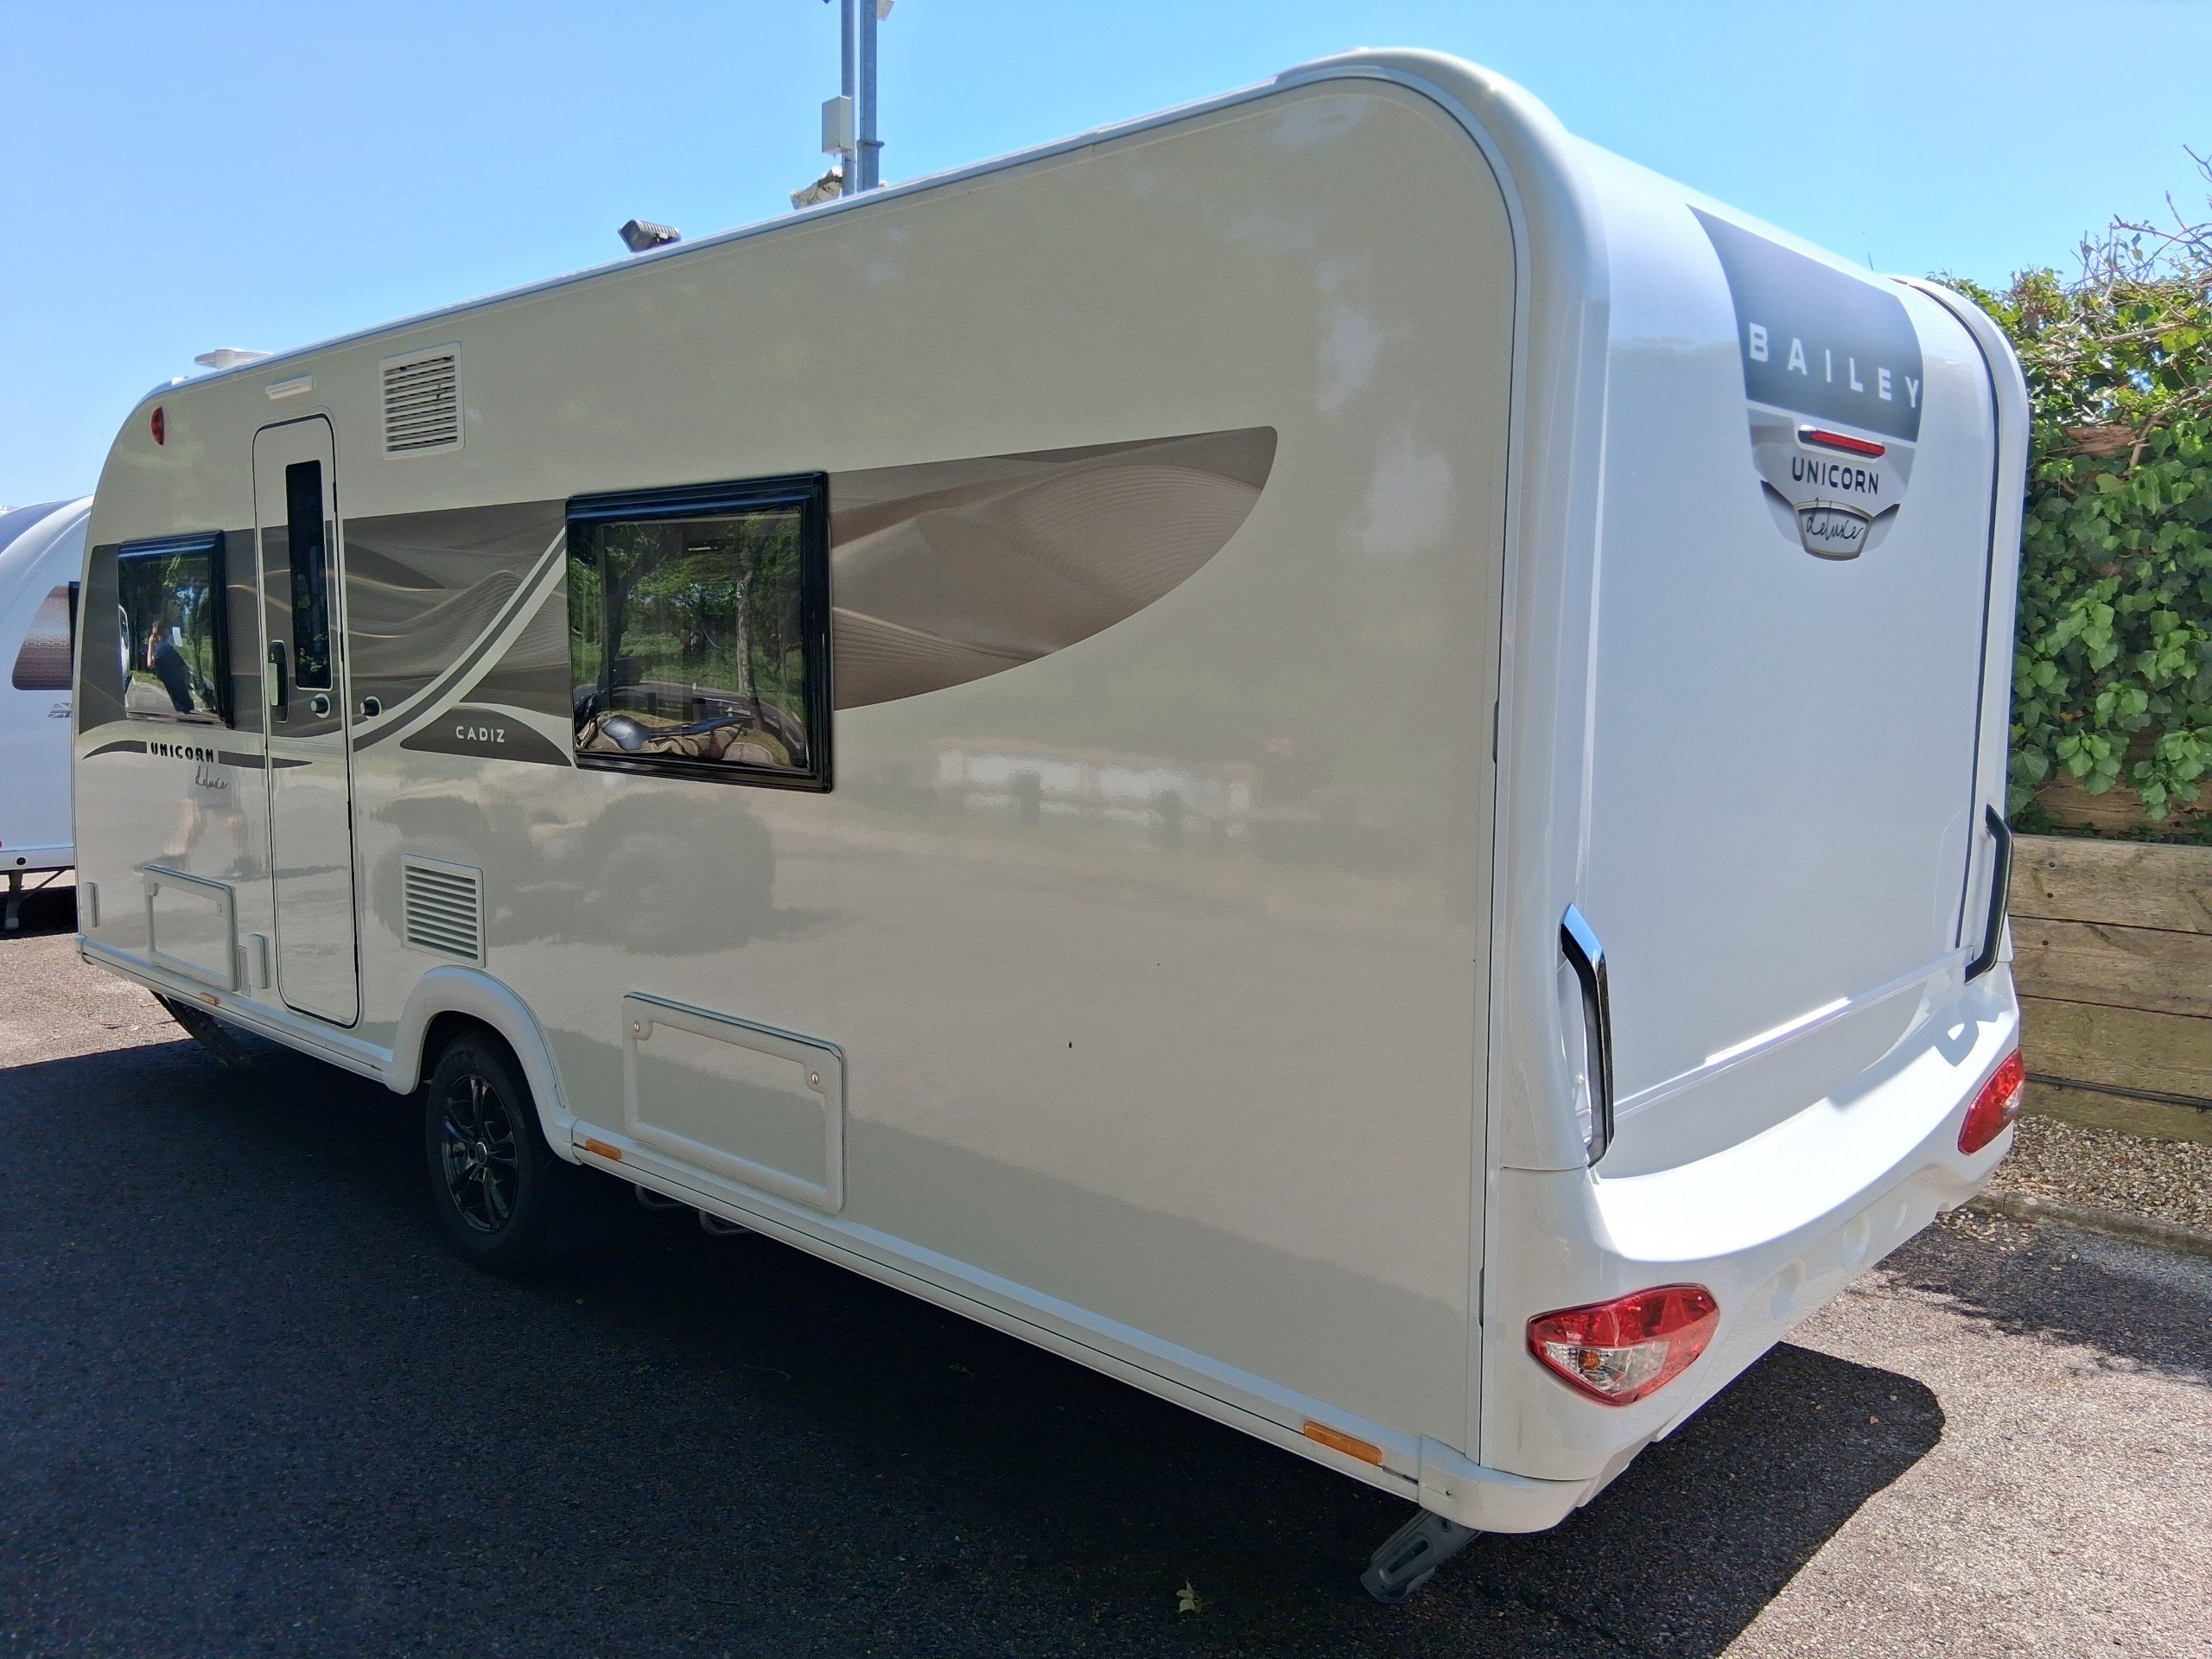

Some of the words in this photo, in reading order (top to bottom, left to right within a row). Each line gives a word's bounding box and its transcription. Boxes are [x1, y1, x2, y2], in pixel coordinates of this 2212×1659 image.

[1749, 321, 1919, 409] BAILEY
[1792, 456, 1879, 495] UNICORN
[455, 726, 505, 743] CADIZ
[150, 741, 214, 764] UNICORN
